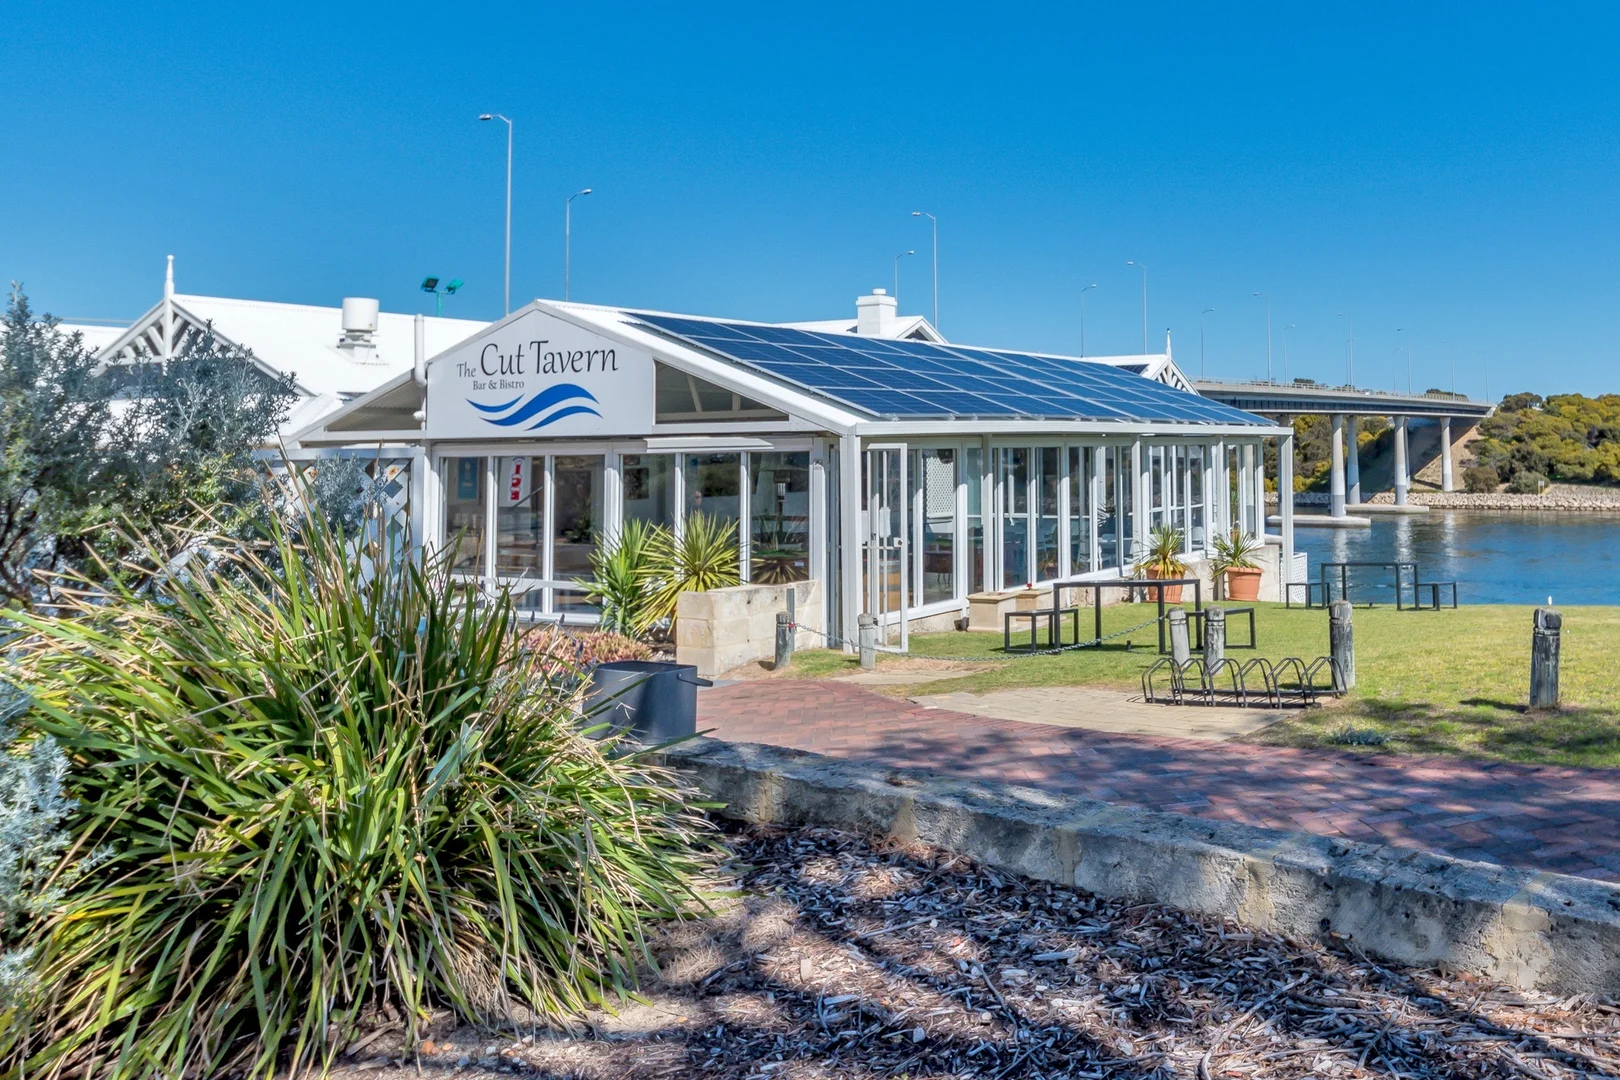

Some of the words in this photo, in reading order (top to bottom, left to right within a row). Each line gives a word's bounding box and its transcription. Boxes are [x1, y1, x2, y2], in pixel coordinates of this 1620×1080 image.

[457, 361, 476, 378] The
[480, 343, 525, 376] Cut
[529, 340, 619, 374] Tavern
[472, 379, 486, 391] Bar
[488, 379, 498, 390] &
[499, 378, 525, 390] Bistro
